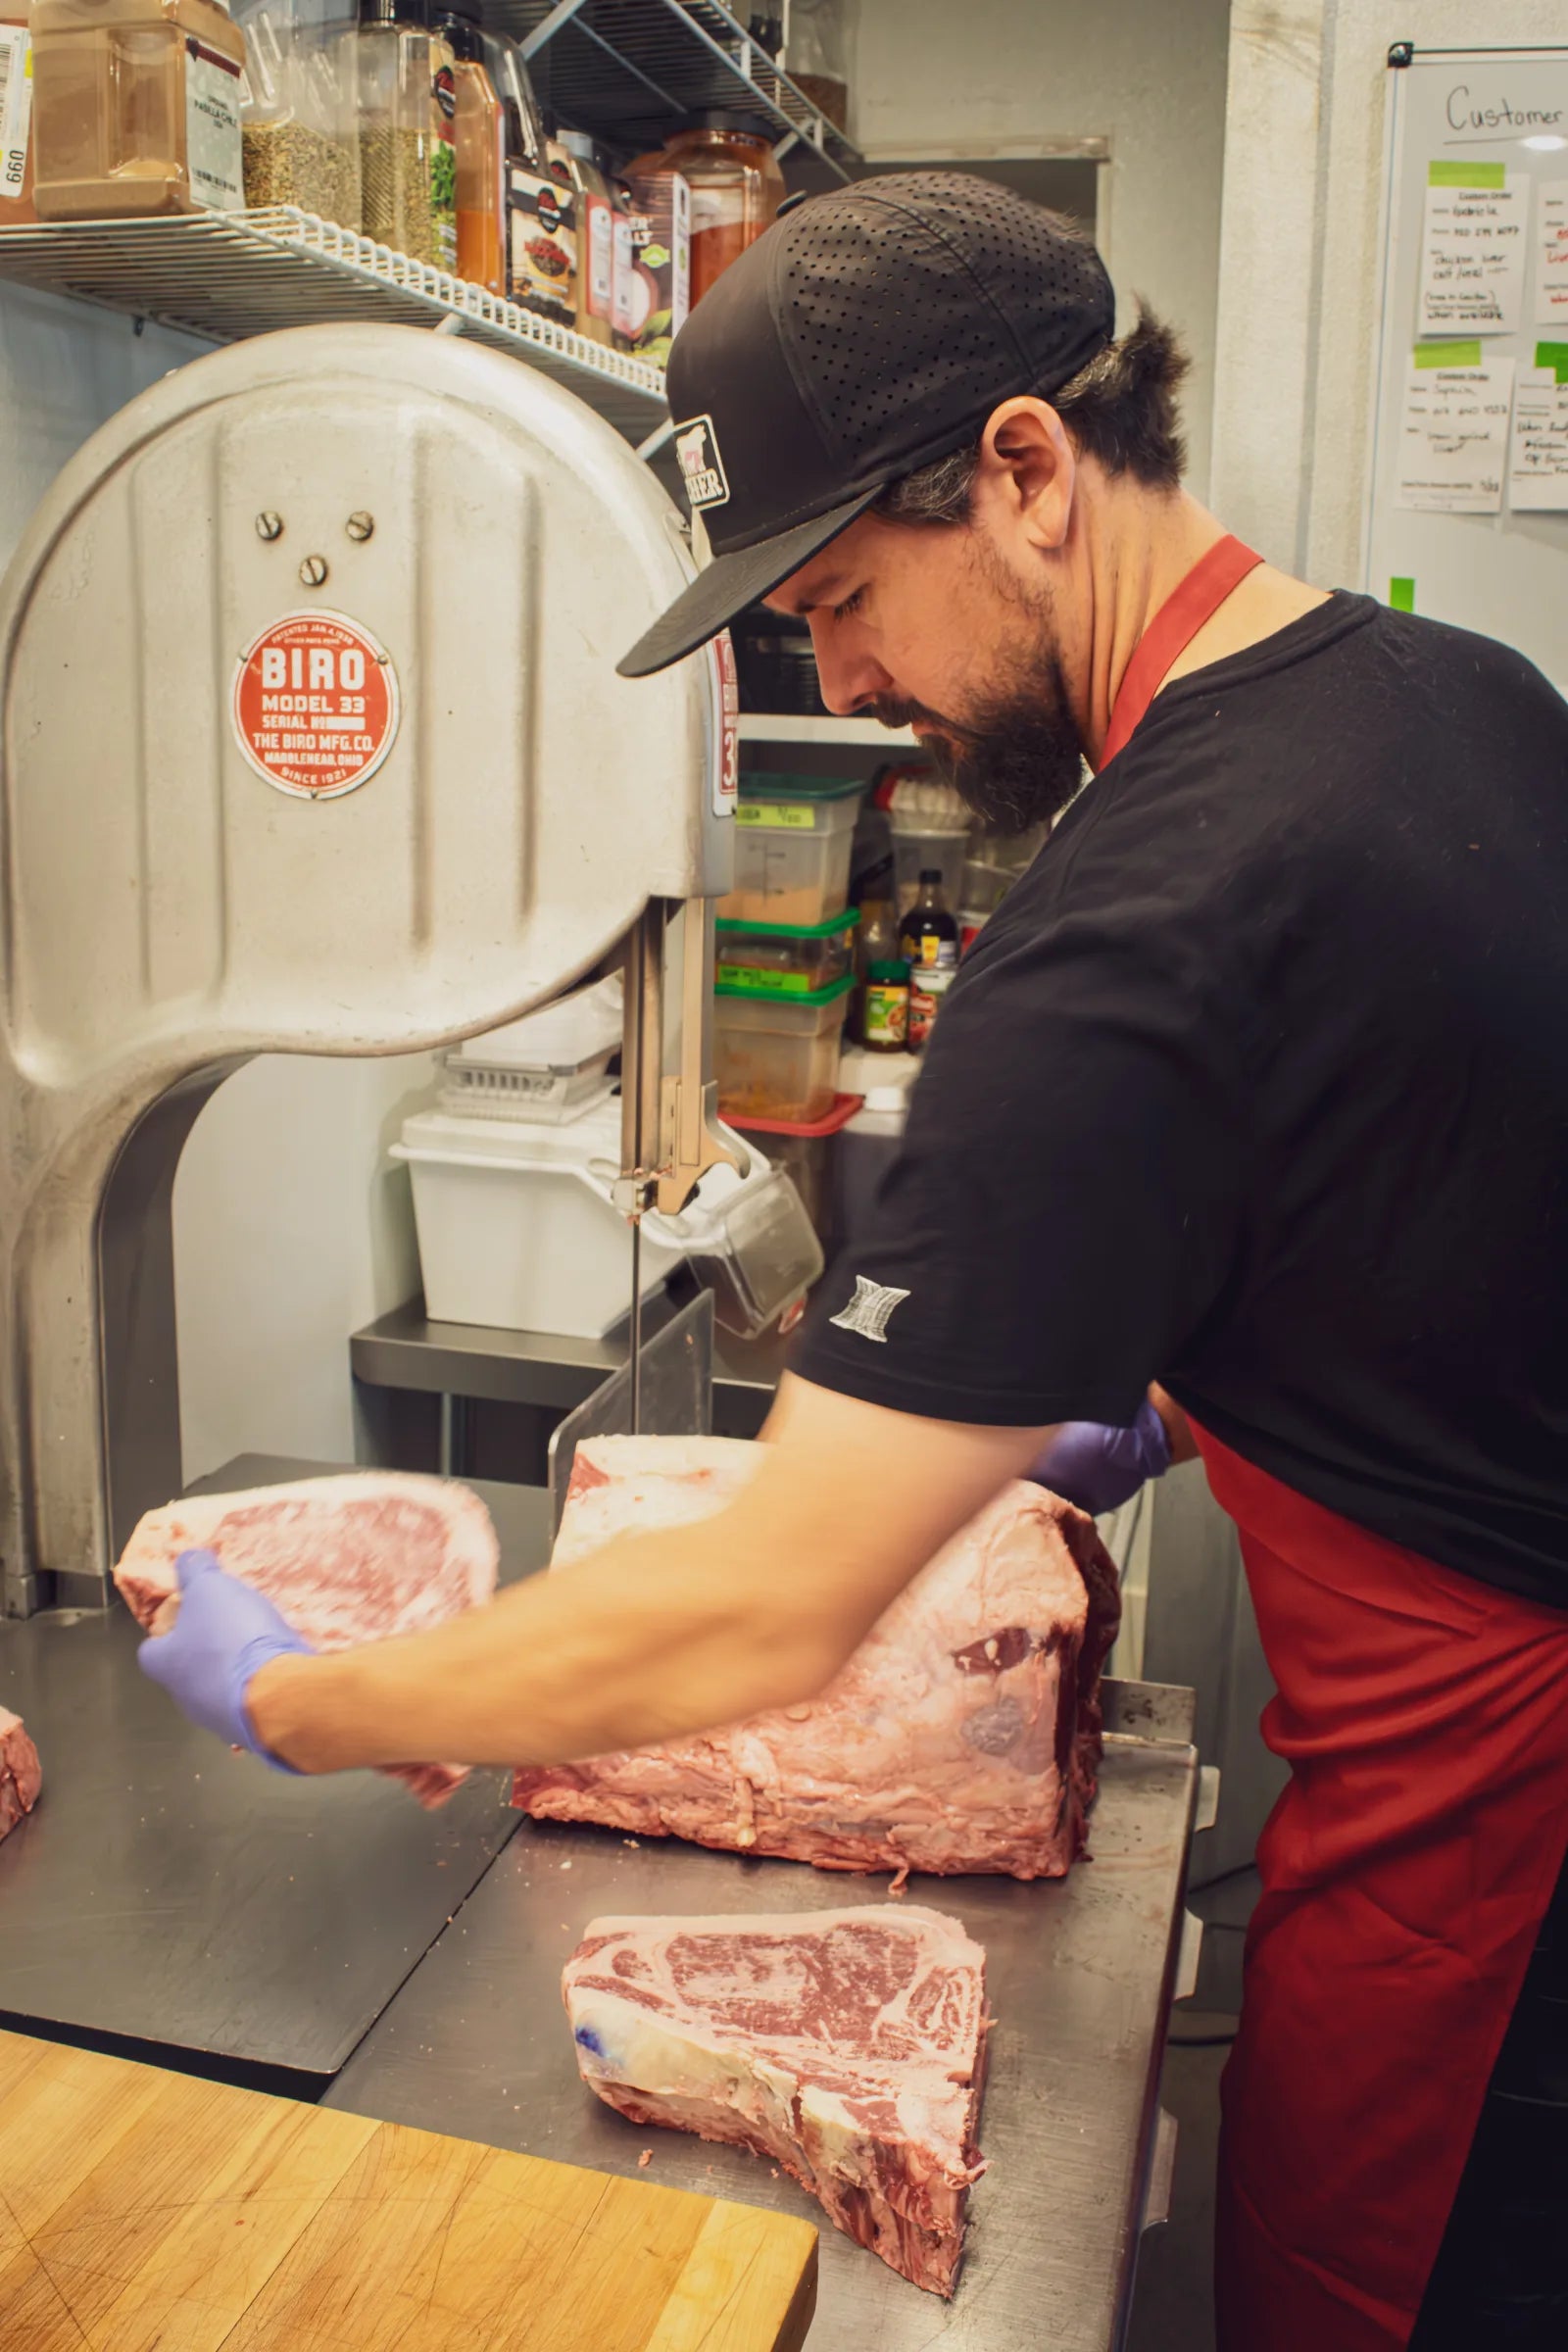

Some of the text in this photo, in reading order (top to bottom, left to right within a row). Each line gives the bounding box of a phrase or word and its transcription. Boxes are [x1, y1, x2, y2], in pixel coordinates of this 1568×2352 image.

[1446, 85, 1563, 130] Customer
[262, 648, 365, 690] BIRO
[262, 695, 366, 713] MODEL 33
[262, 714, 308, 729] SERIAL
[252, 732, 280, 749] THE
[282, 733, 316, 750] BIRO
[337, 754, 364, 766] OHIO
[280, 766, 318, 784] SINCE
